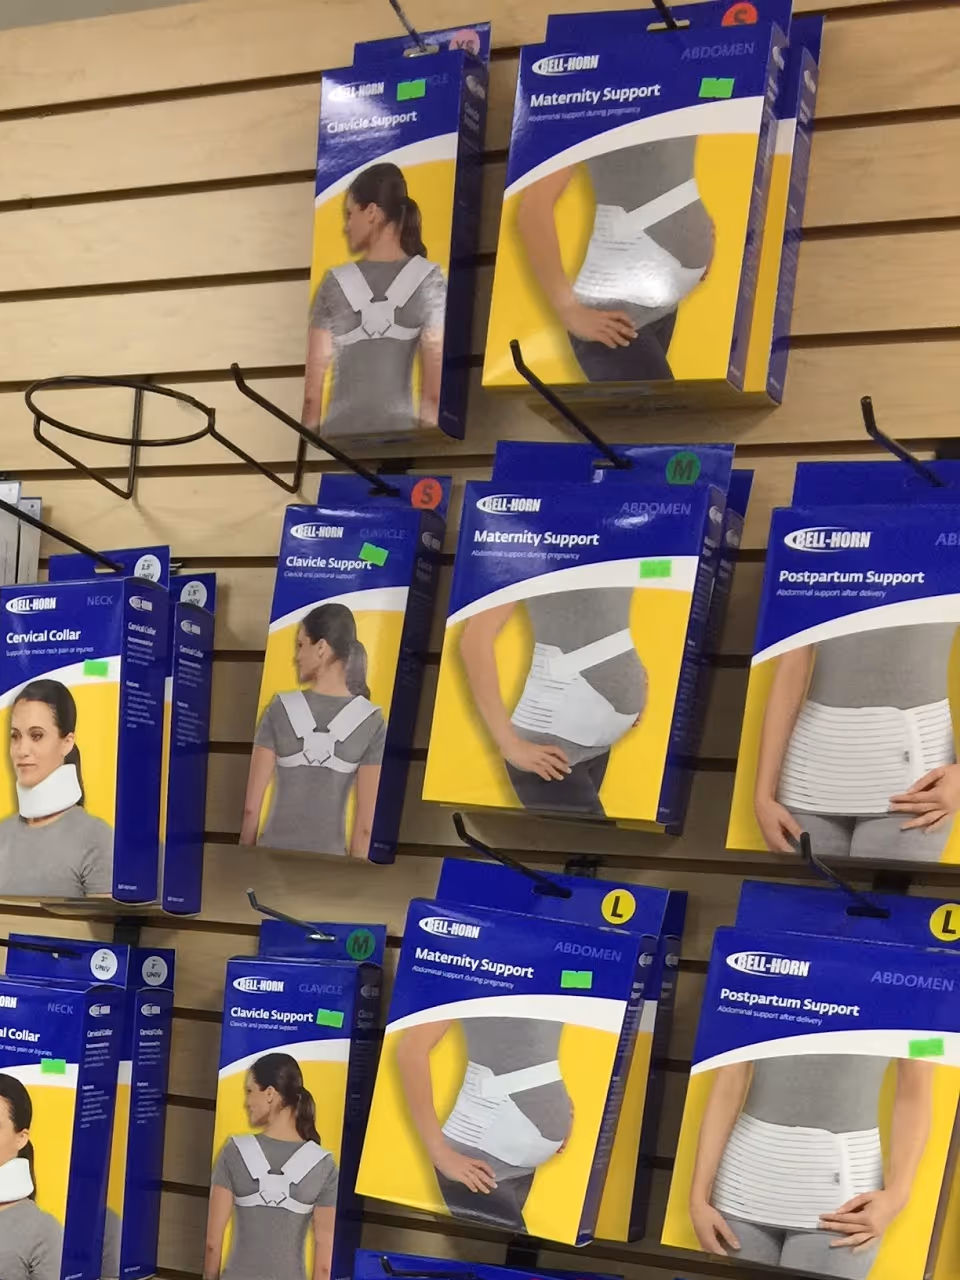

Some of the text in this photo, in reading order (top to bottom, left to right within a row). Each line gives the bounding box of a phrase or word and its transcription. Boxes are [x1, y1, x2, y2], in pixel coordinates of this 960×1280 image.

[681, 42, 755, 60] ABDOMEN
[539, 54, 600, 74] BELL-HORN
[530, 84, 661, 108] Maternity Support
[327, 111, 418, 133] Clavicle Support
[672, 458, 695, 480] M
[421, 484, 433, 505] S
[483, 497, 541, 513] BELL-HORN
[620, 502, 692, 515] ABDOMEN
[297, 525, 344, 538] BELL-HORN
[474, 530, 600, 548] Maternity Support
[795, 530, 872, 548] BELL-HORN
[286, 556, 372, 571] Clavicle Support
[779, 570, 925, 586] Postpartum Support
[87, 595, 113, 606] NECK
[776, 588, 886, 598] Abdominal support after delivery
[11, 597, 57, 611] BELL-HORN
[6, 629, 81, 644] Cervical Collar
[610, 895, 624, 918] L
[426, 920, 480, 940] BELL-HORN
[941, 910, 956, 935] L
[352, 936, 369, 953] M
[554, 942, 622, 962] ABDOMEN
[415, 947, 534, 980] Maternity Support
[737, 954, 811, 977] BELL-HORN
[238, 979, 285, 993] BELL-HORN
[299, 983, 343, 995] CLAVICLE
[871, 970, 955, 992] ABDOMEN
[47, 1002, 74, 1015] NECK
[720, 988, 860, 1017] Postpartum Support
[230, 1007, 313, 1024] Clavicle Support
[717, 1005, 822, 1026] Abdominal support after delivery
[9, 1028, 41, 1042] Collar
